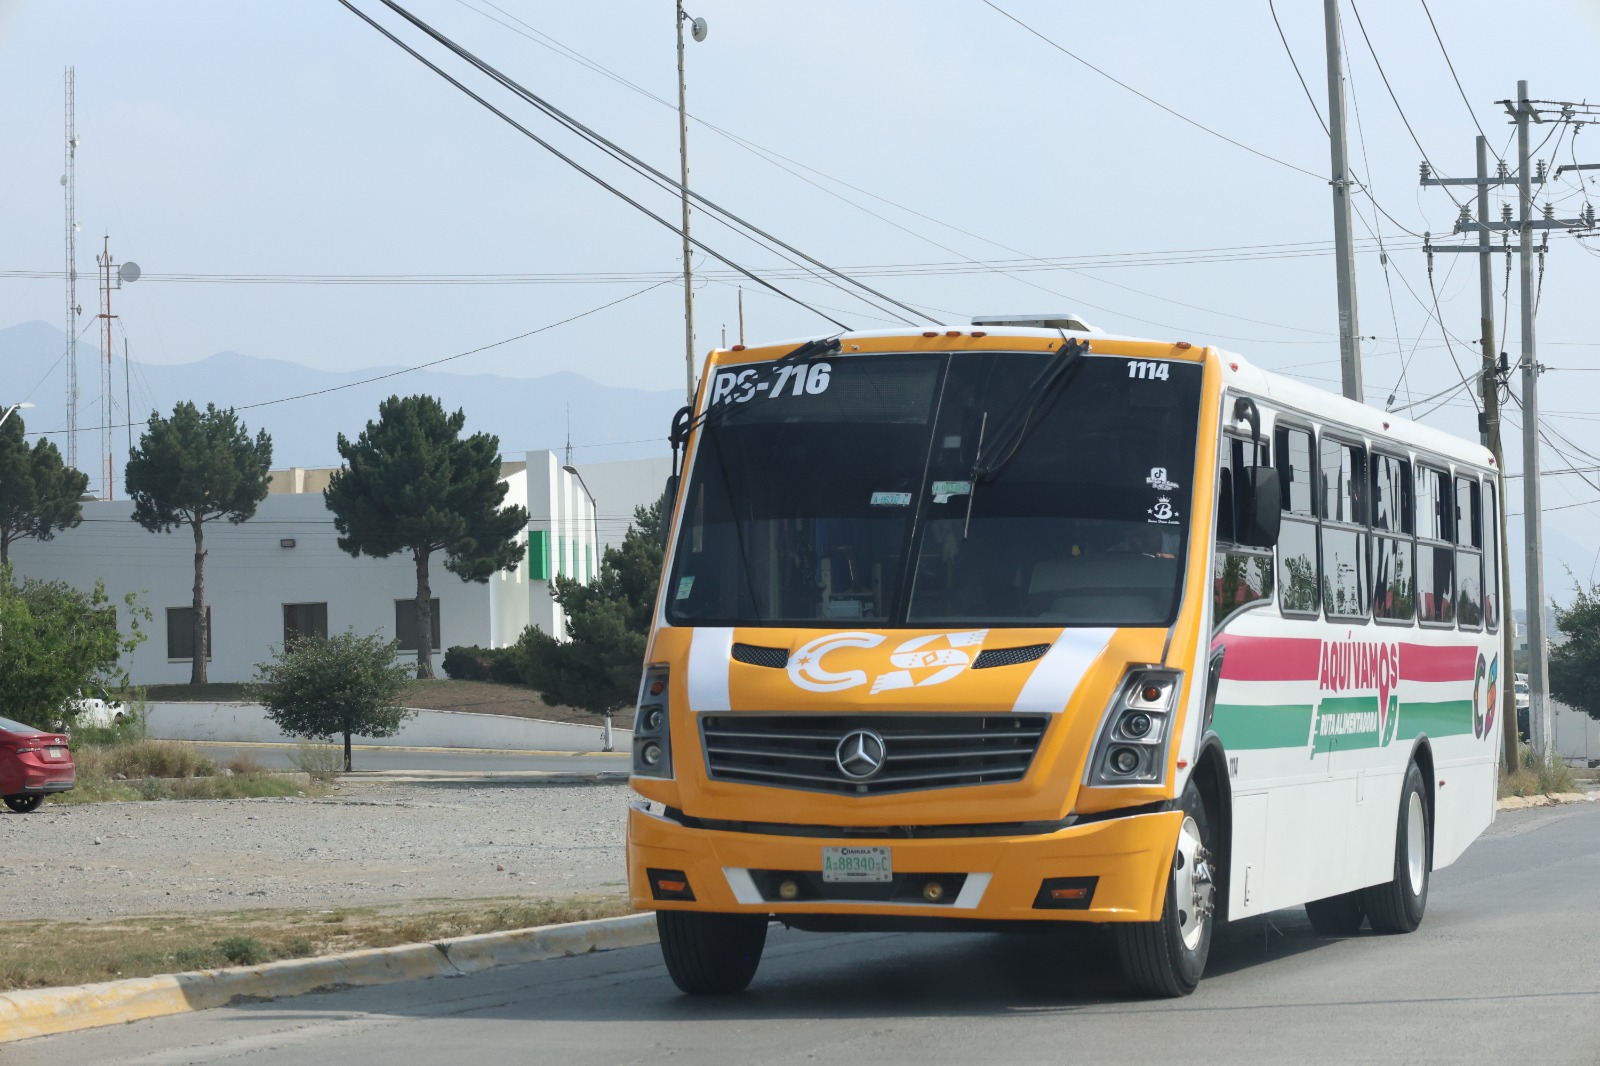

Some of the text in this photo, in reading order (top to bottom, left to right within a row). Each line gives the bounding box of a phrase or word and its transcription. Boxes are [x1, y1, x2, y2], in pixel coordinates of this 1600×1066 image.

[1127, 360, 1169, 381] 1114
[712, 362, 832, 406] RS-716
[1319, 711, 1378, 736] RUTA ALIMENTADORA
